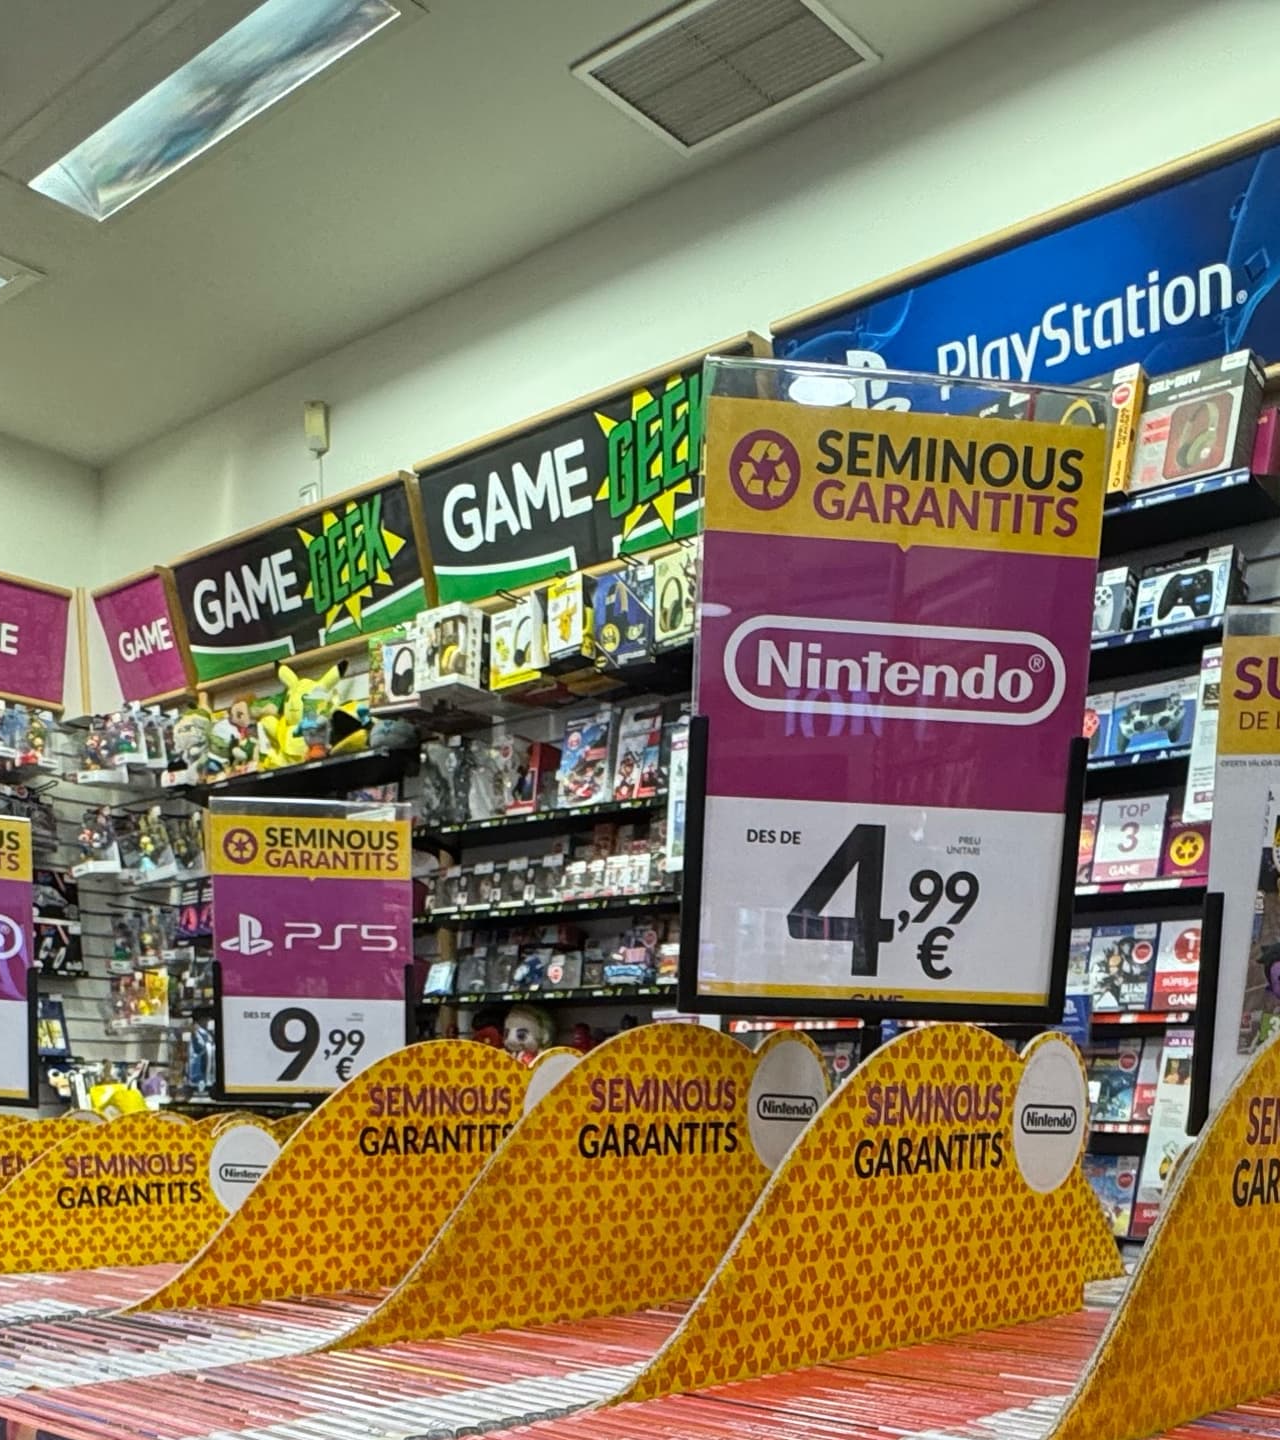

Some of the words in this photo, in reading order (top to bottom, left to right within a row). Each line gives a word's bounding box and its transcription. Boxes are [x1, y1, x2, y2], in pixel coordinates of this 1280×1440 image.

[816, 430, 1085, 493] SEMINOUS
[442, 438, 592, 553] GAME
[813, 479, 1079, 538] GARANTITS
[192, 548, 303, 636] GAME
[307, 495, 390, 615] GEEK
[118, 617, 174, 663] GAME
[1239, 711, 1271, 730] DE
[265, 826, 399, 852] SEMINOUS
[746, 828, 776, 844] DES
[780, 830, 801, 845] DE
[265, 849, 399, 872] GARANTITS
[284, 922, 399, 952] PS5
[917, 926, 955, 980] €
[368, 1085, 513, 1119] SEMINOUS
[589, 1078, 738, 1114] SEMINOUS
[865, 1083, 1004, 1128] SEMINOUS
[577, 1121, 739, 1160] GARANTITS
[853, 1133, 1005, 1179] GARANTITS
[63, 1153, 199, 1180] SEMINOUS
[56, 1182, 204, 1210] GARANTITS
